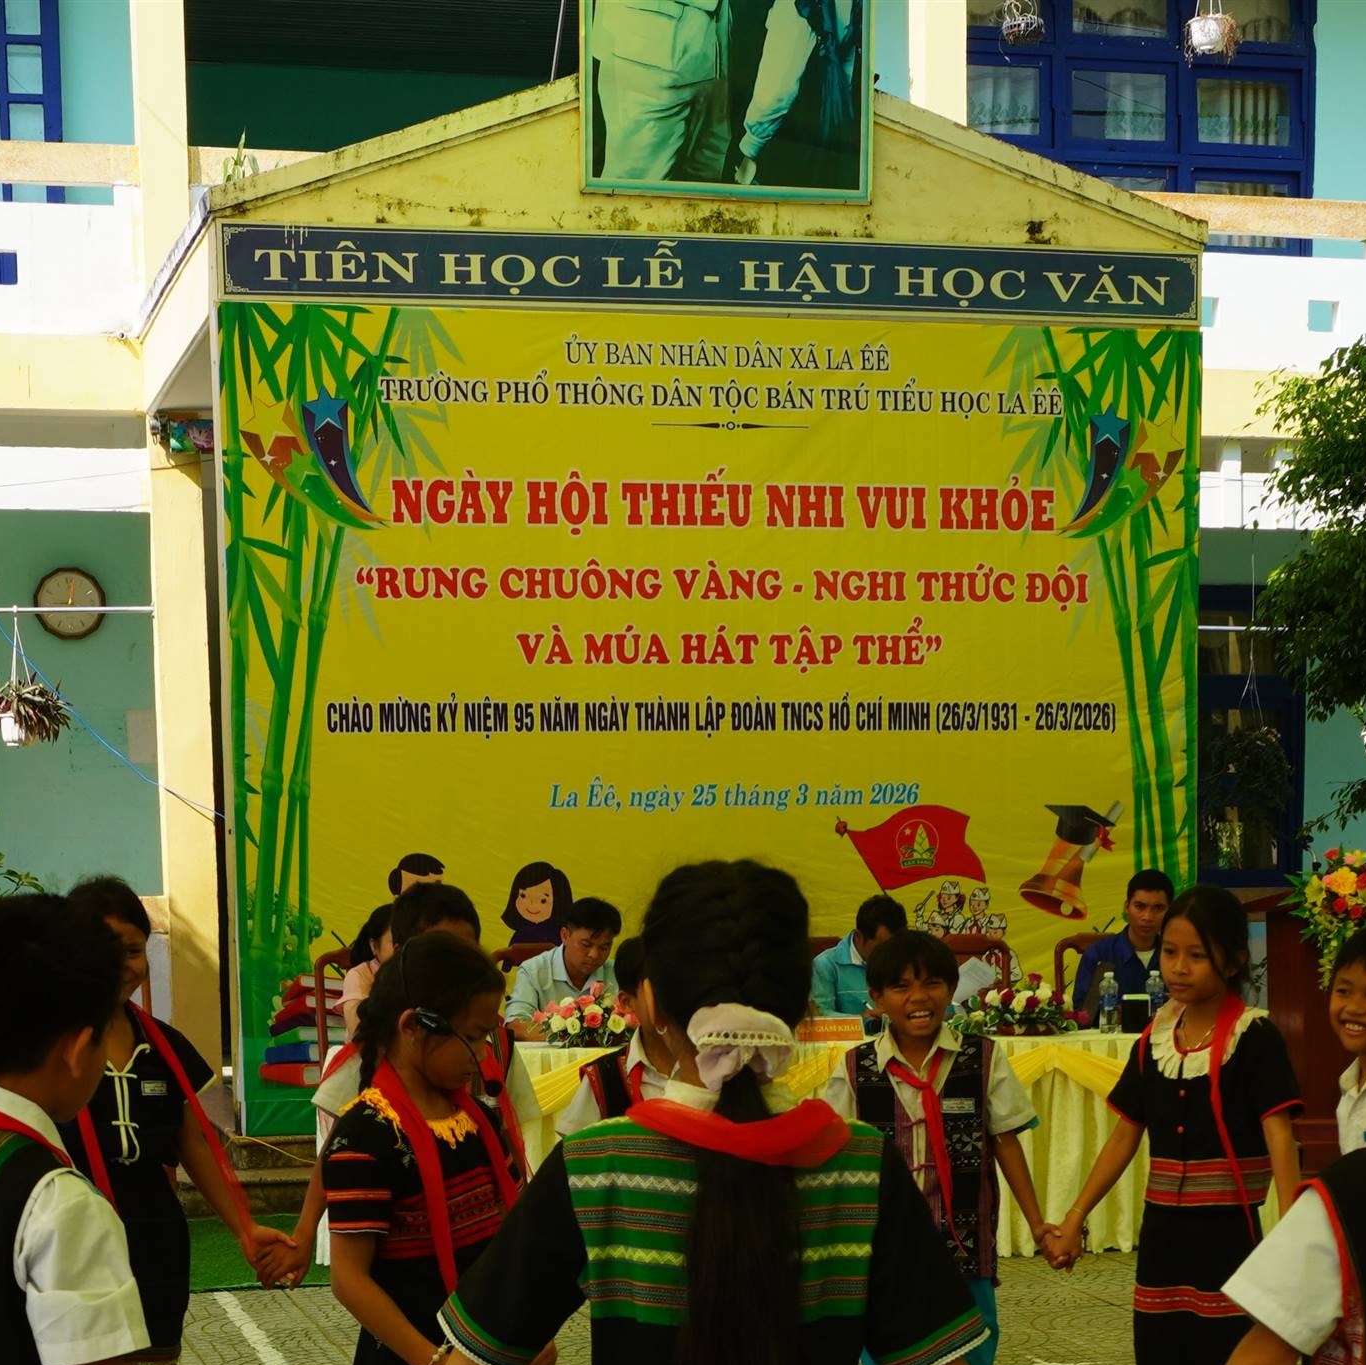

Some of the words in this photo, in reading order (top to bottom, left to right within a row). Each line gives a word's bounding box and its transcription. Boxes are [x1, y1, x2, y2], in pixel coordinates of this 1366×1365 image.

[254, 240, 419, 284] TIÊN
[439, 253, 581, 295] HỌC
[601, 239, 683, 289] LỄ
[739, 252, 875, 301] HẬU
[895, 267, 1026, 307] HỌC
[1042, 265, 1170, 306] VĂN
[565, 334, 598, 364] ỦY
[605, 343, 653, 366] BAN
[660, 339, 727, 368] NHÂN
[735, 341, 782, 369] DÂN
[789, 343, 820, 369] XÃ
[825, 349, 854, 370] LA
[860, 344, 889, 371] ÊÊ
[380, 371, 488, 403] TRƯỜNG
[497, 369, 549, 404] PHỔ
[556, 376, 644, 406] THÔNG
[651, 378, 702, 407] DÂN
[709, 379, 758, 414] TỘC
[766, 380, 814, 409] BÁN
[821, 383, 869, 411] TRÚ
[876, 378, 933, 413] TIỂU
[940, 391, 990, 419] HỌC
[997, 392, 1026, 415] LA
[1032, 387, 1063, 415] ÊÊ
[391, 470, 513, 524] NGÀY
[527, 471, 608, 535] HỘI
[622, 466, 752, 526] THIẾU
[765, 484, 845, 528] NHI
[856, 486, 927, 530] VUI
[939, 476, 1055, 531] KHỎE
[356, 567, 488, 599] “RUNG
[499, 559, 662, 599] CHUÔNG
[673, 560, 783, 600] VÀNG
[813, 570, 905, 601] NGHI
[917, 563, 1015, 602] THỨC
[1025, 564, 1088, 612] ĐỘI
[516, 624, 573, 664] VÀ
[584, 624, 670, 664] MÚA
[681, 624, 758, 665] HÁT
[769, 625, 843, 674] TẬP
[853, 616, 942, 665] THỂ”
[327, 697, 373, 733] CHÀO
[379, 697, 431, 733] MỪNG
[437, 692, 458, 733] KỶ
[464, 696, 508, 739] NIỆM
[514, 702, 534, 733] 95
[540, 696, 579, 732] NĂM
[585, 696, 629, 732] NGÀY
[635, 696, 690, 732] THÀNH
[695, 696, 726, 738] LẬP
[731, 695, 776, 731] ĐOÀN
[781, 702, 823, 731] TNCS
[829, 692, 850, 731] HỒ
[855, 695, 883, 731] CHÍ
[888, 702, 930, 731] MINH
[936, 701, 1018, 734] (26/3/1931
[1035, 701, 1116, 734] 26/3/2026)
[549, 783, 579, 808] La
[587, 775, 621, 812] Êê,
[629, 784, 686, 813] ngày
[690, 784, 717, 807] 25
[724, 784, 791, 811] tháng
[796, 784, 809, 806] 3
[815, 784, 864, 806] năm
[869, 782, 920, 805] 2026
